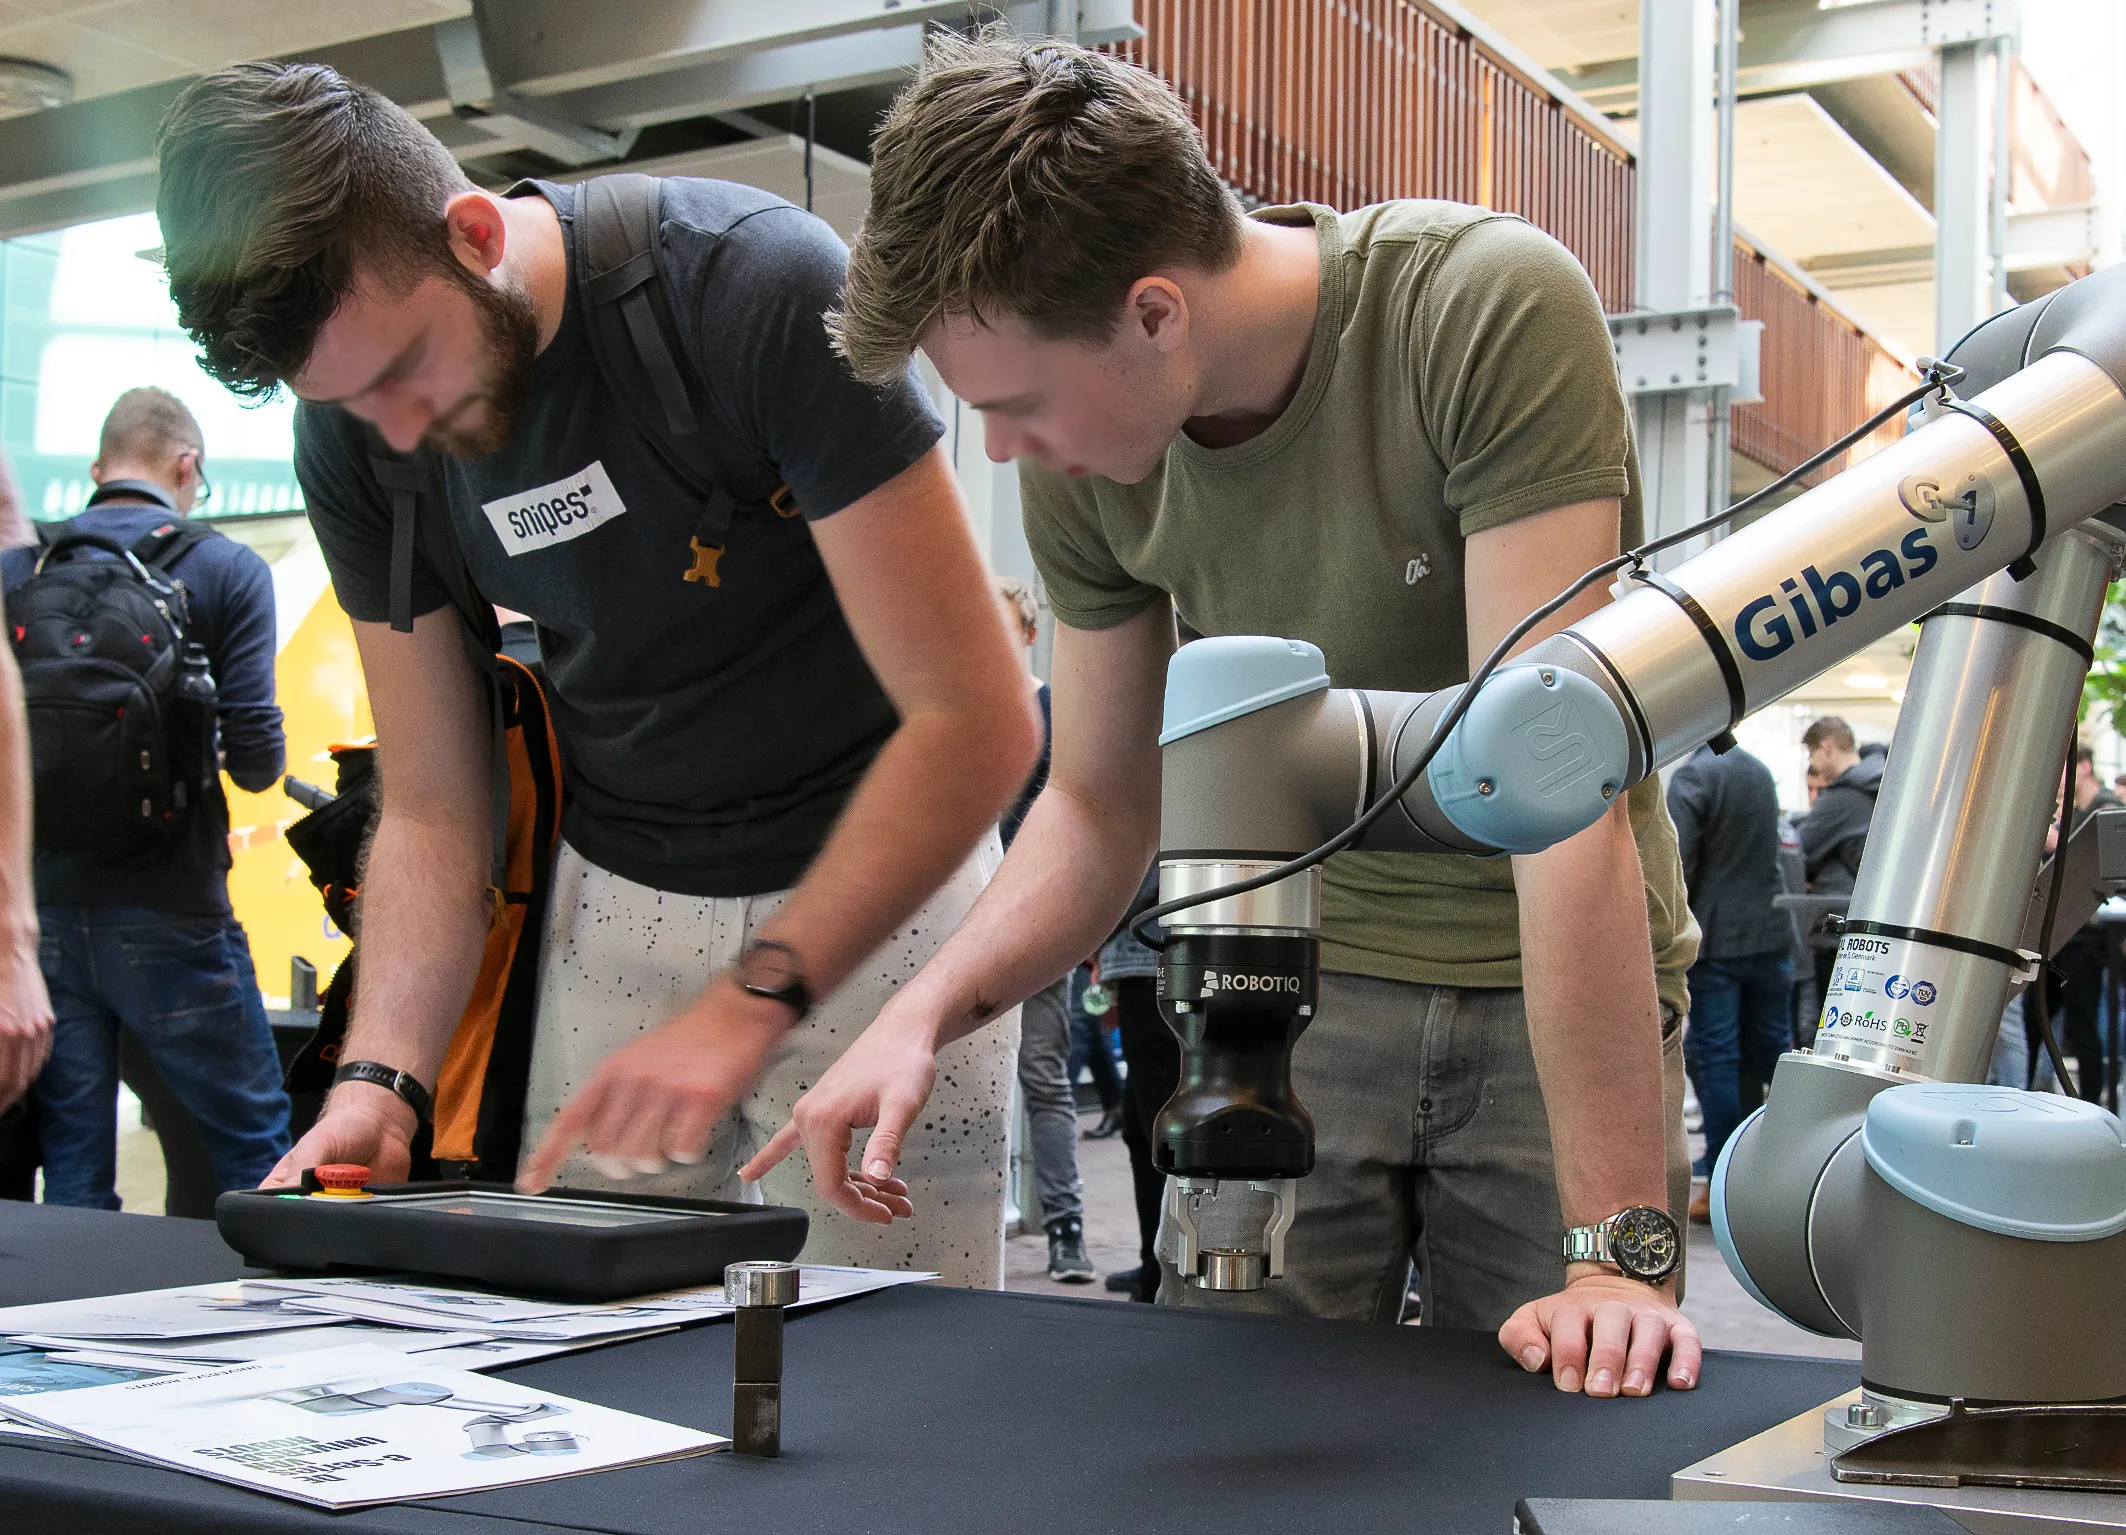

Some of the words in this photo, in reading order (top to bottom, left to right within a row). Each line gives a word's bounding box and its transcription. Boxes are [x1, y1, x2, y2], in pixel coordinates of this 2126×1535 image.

[507, 491, 589, 539] snipes
[1734, 526, 1938, 662] Gibas
[1847, 938, 1890, 955] ROBOTS
[1222, 974, 1300, 994] ROBOTIQ
[1855, 1015, 1888, 1032] RoHS
[125, 1378, 181, 1390] ROBOTS
[192, 1435, 320, 1458] ROBOTS
[214, 1435, 389, 1463] UNIVERSAL
[267, 1453, 413, 1477] e-Series
